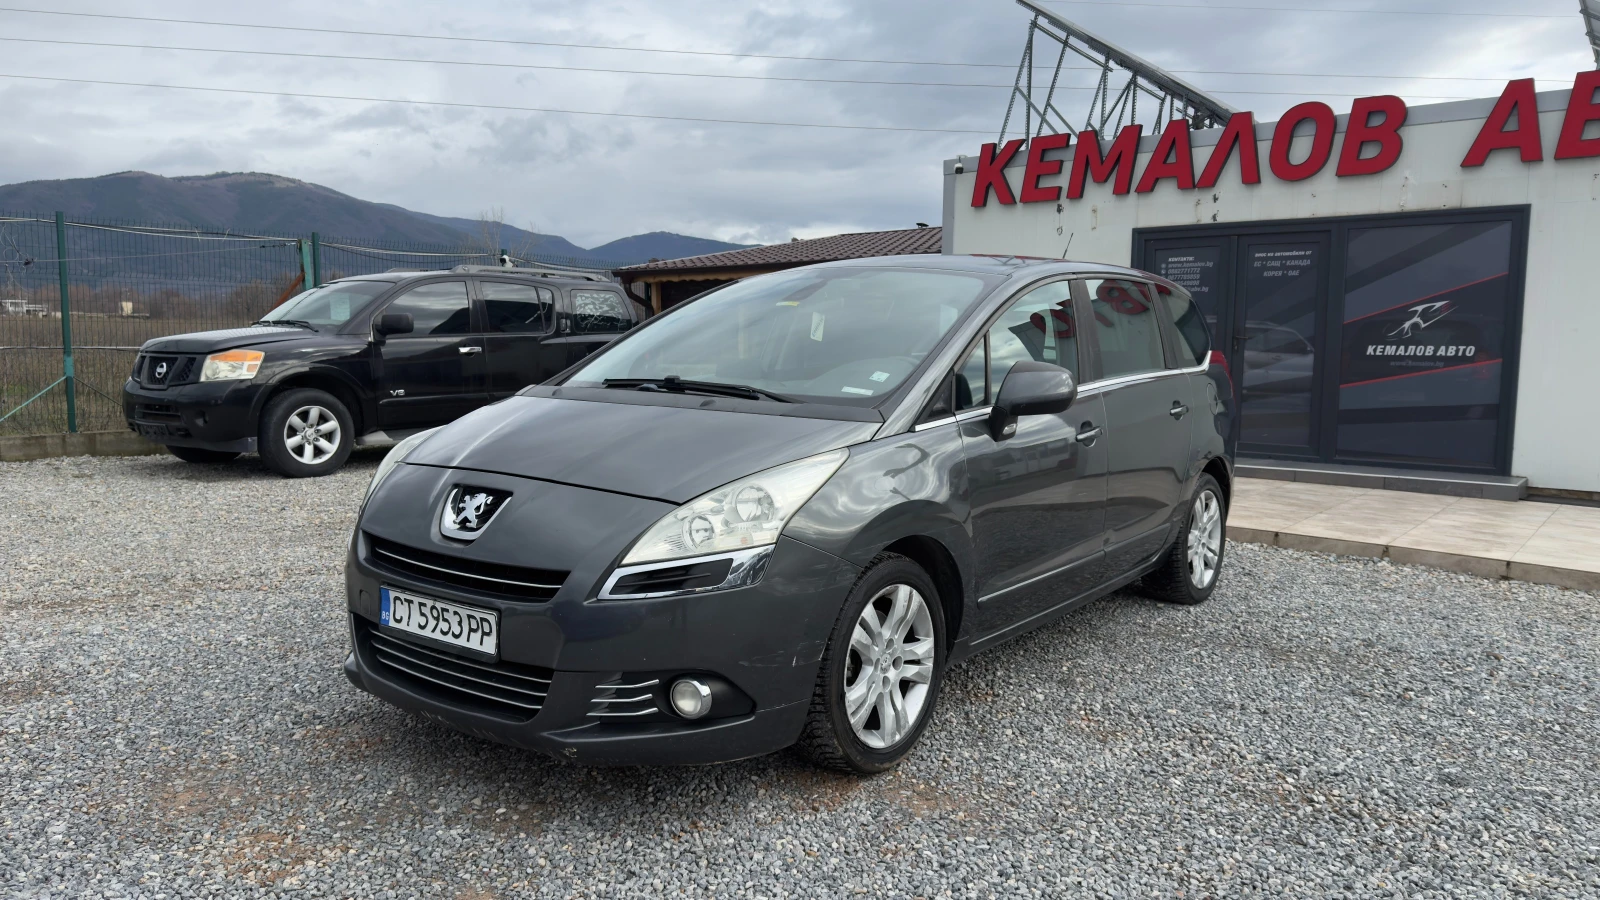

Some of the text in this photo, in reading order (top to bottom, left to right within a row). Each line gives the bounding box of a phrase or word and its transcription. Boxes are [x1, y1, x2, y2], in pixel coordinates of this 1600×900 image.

[971, 95, 1408, 208] КЕМАЛОВ
[1366, 345, 1476, 357] КЕМАЛОВ АВТО
